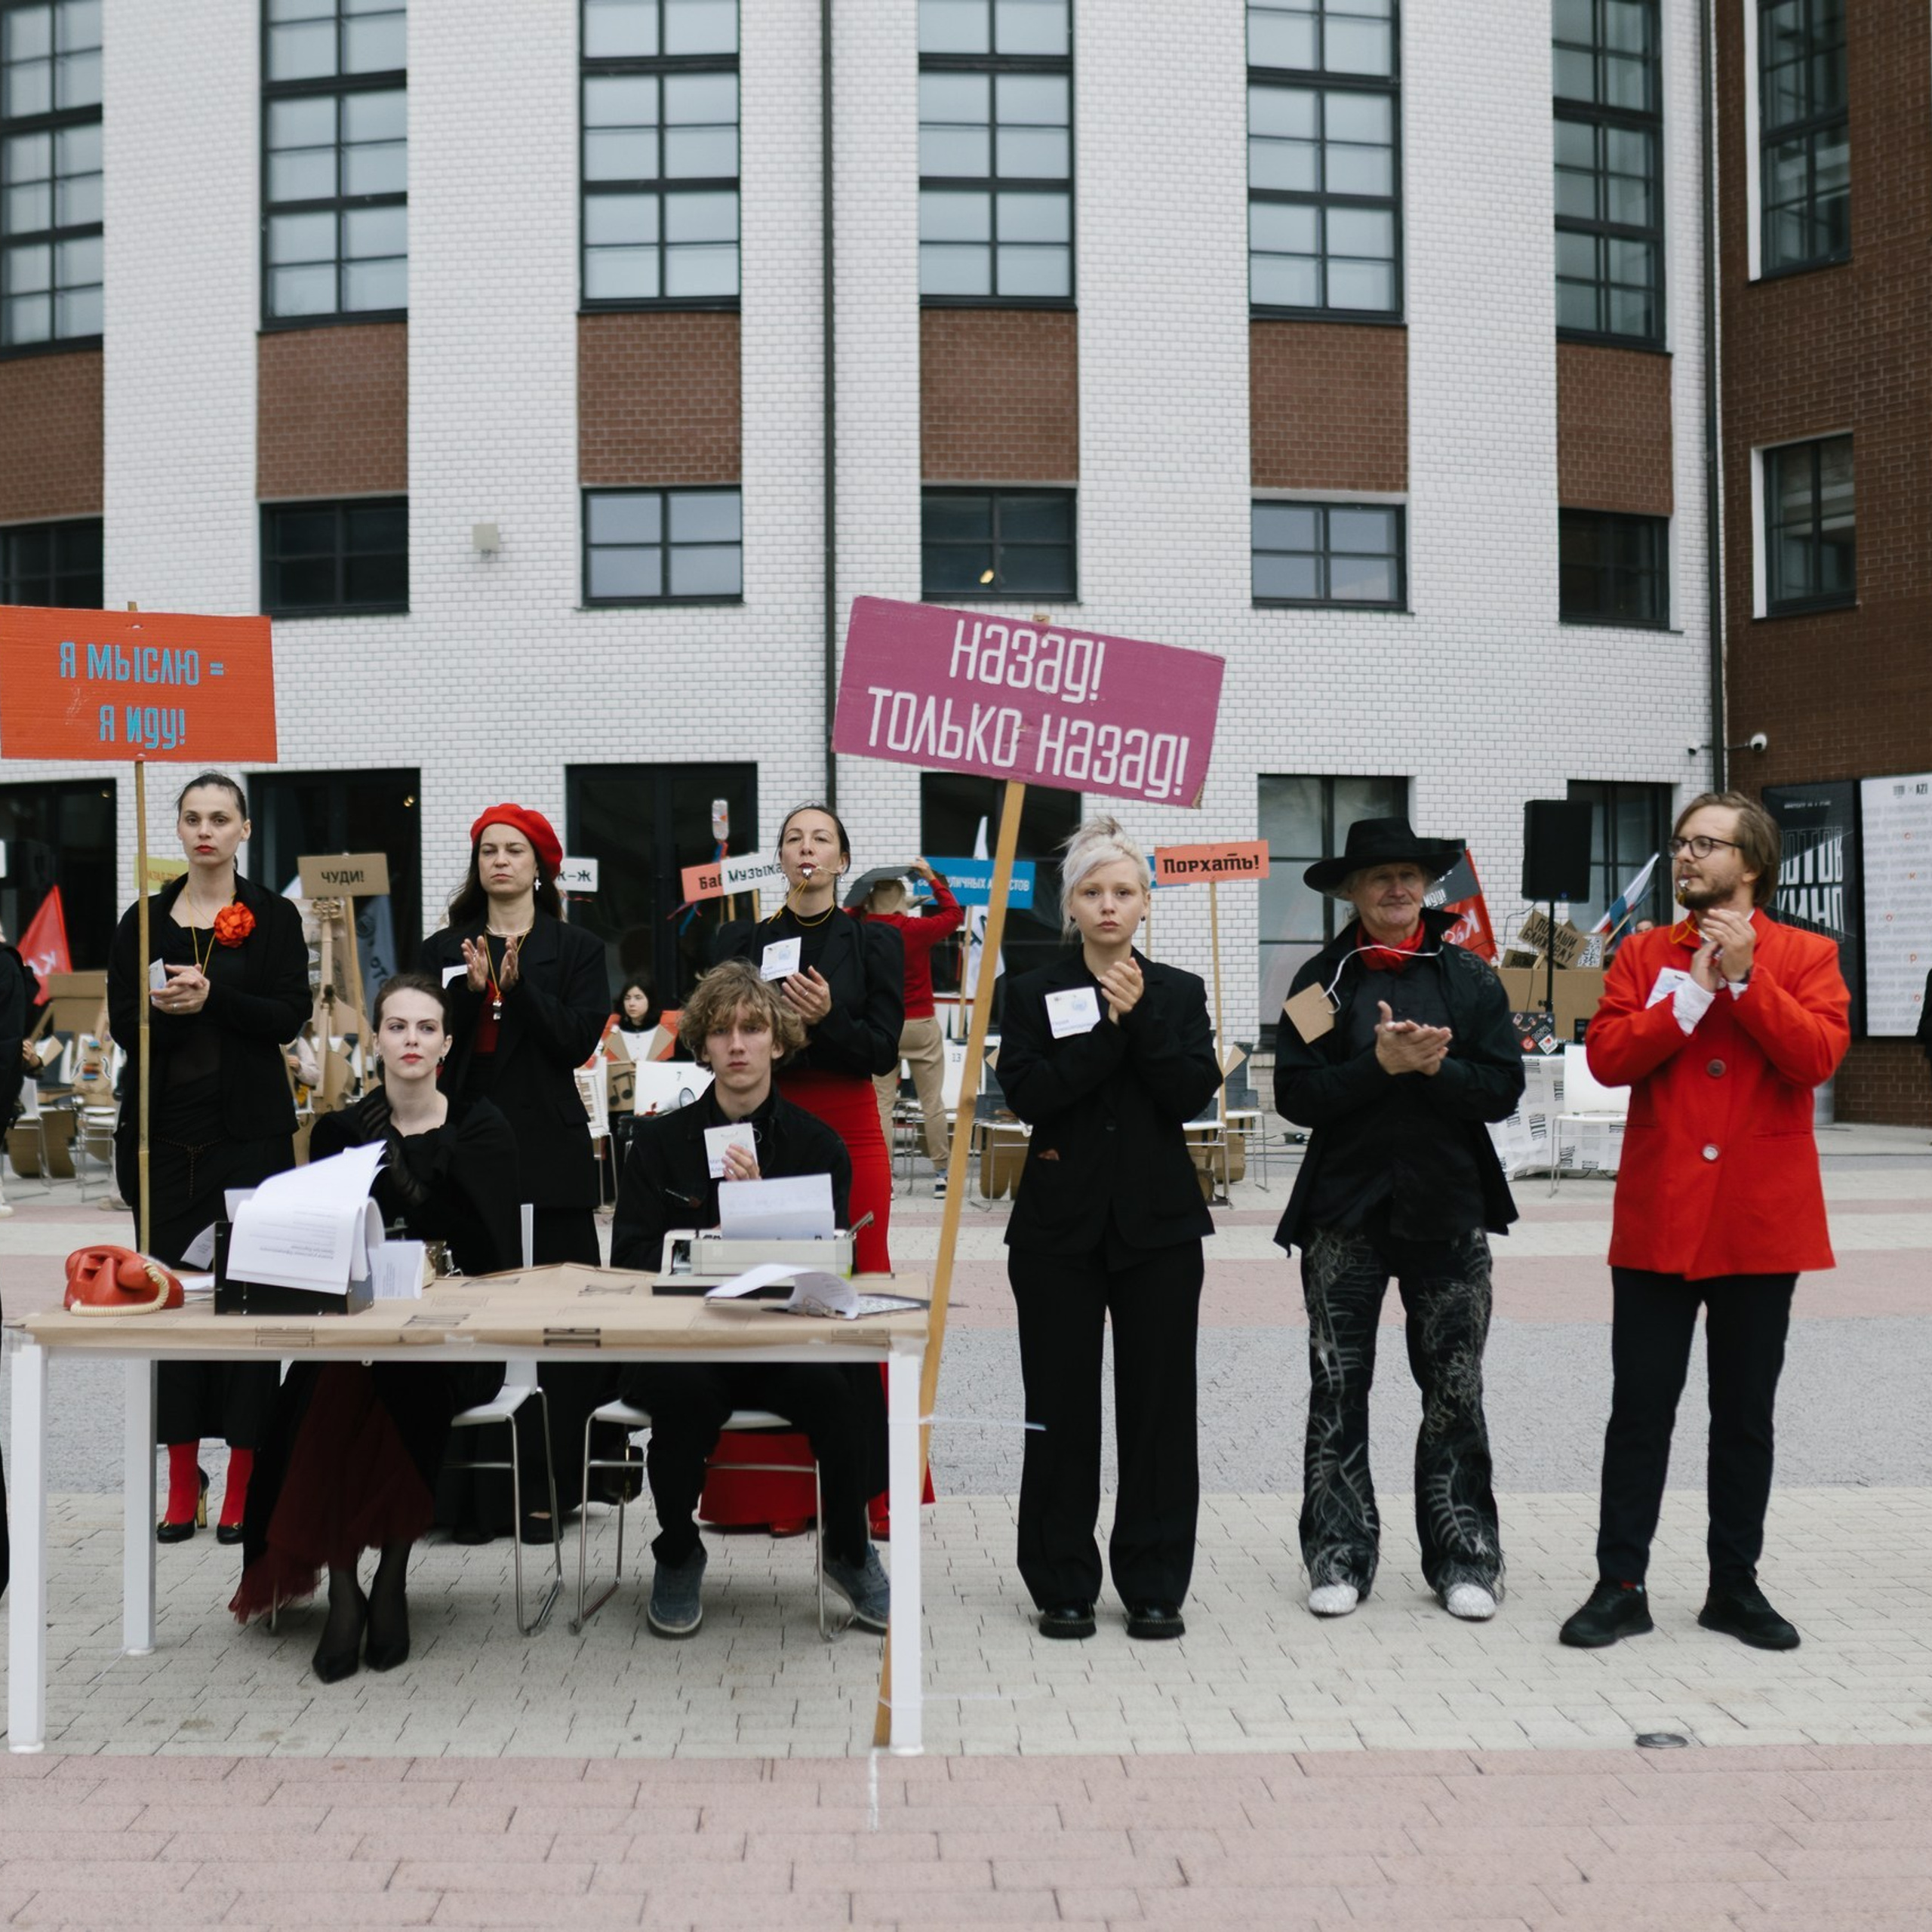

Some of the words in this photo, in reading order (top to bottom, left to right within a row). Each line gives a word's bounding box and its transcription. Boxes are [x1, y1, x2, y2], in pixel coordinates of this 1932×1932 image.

[60, 641, 76, 678] Я
[87, 643, 200, 686] МЫСЛЮ
[99, 704, 115, 742] Я
[867, 686, 1023, 768] ТОЛЬКО
[321, 869, 365, 885] ЧУДИ!
[1162, 852, 1260, 875] Порхать!
[1534, 918, 1577, 949] ПОАШИ
